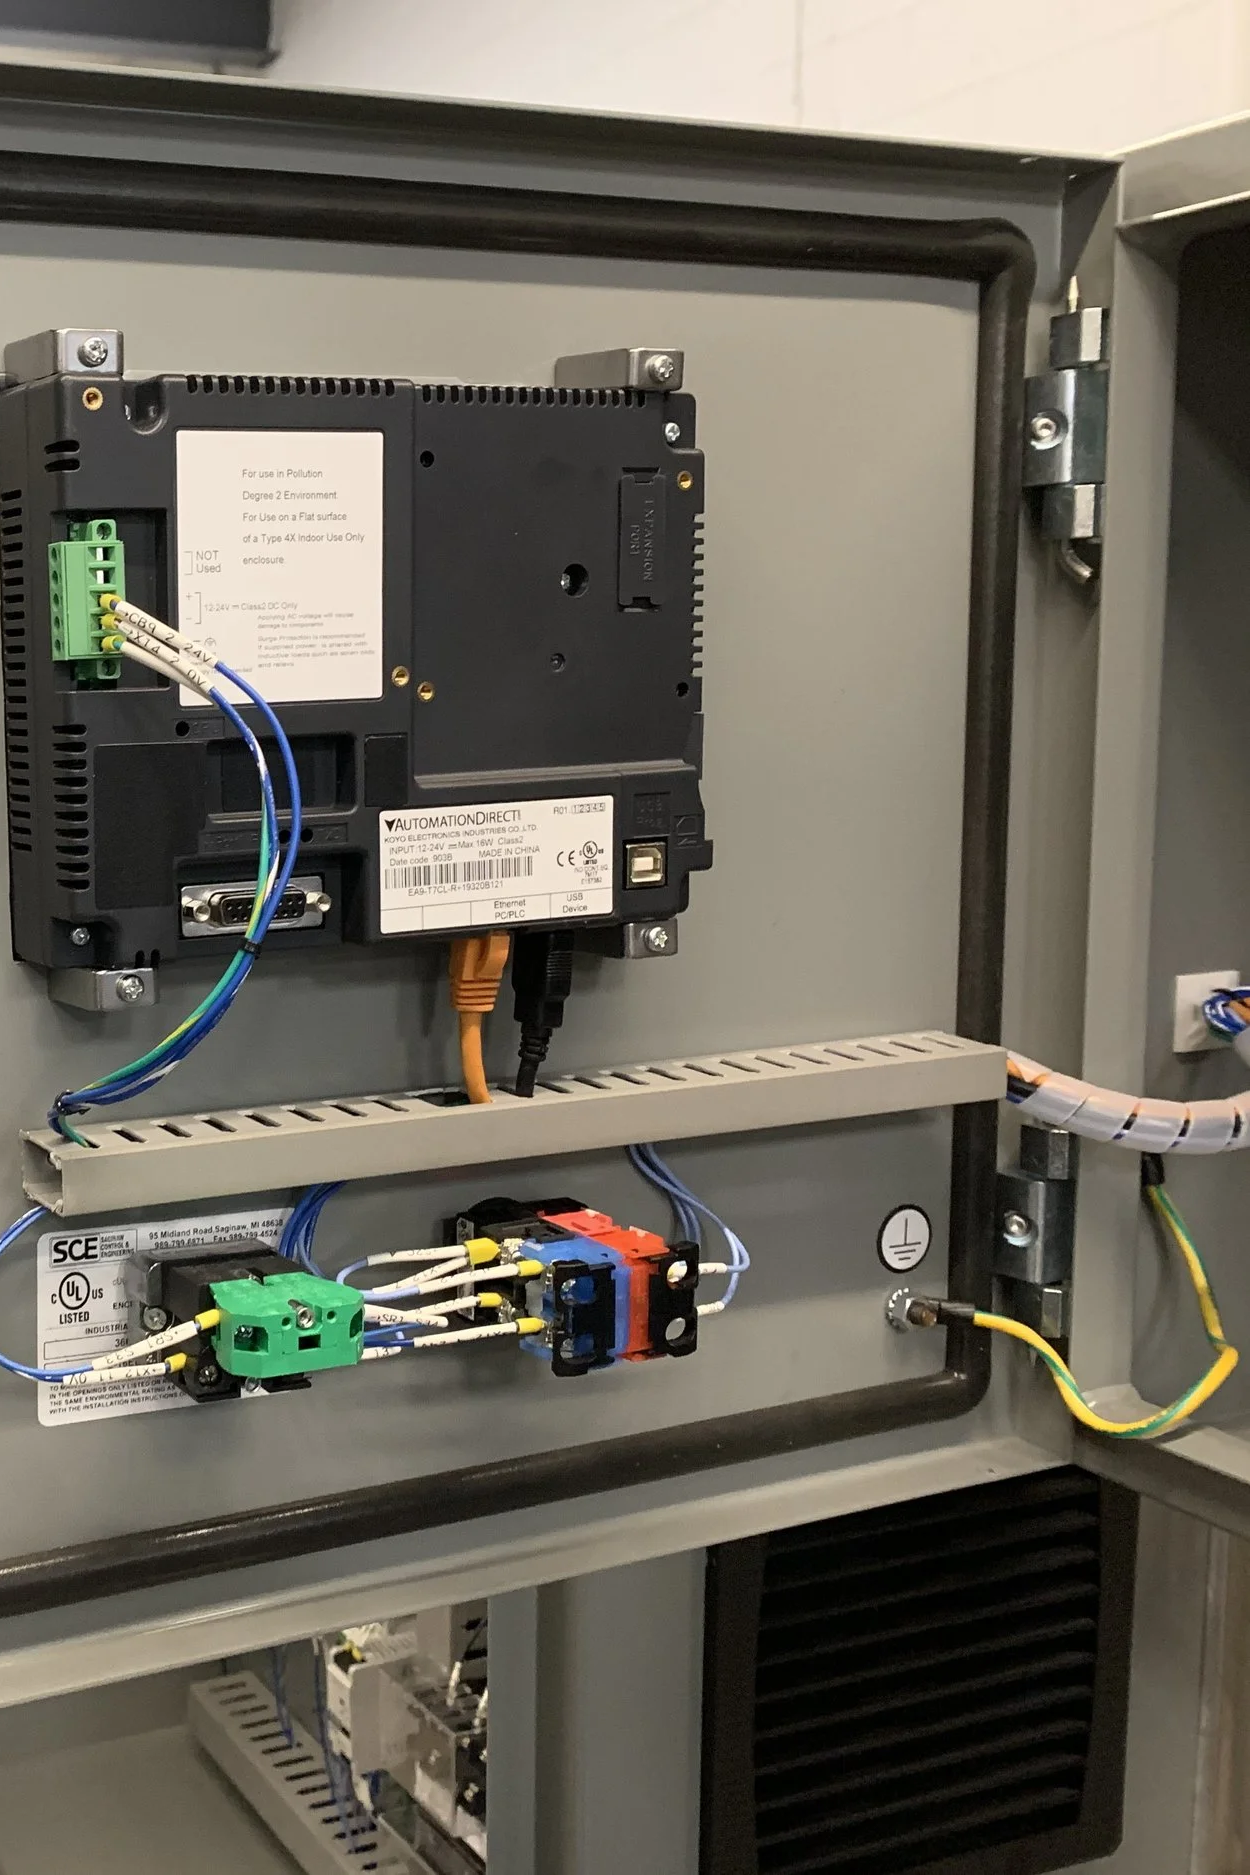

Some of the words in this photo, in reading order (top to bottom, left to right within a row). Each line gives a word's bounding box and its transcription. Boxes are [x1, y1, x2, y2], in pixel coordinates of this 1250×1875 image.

[242, 469, 256, 478] For
[277, 469, 284, 478] in
[286, 469, 323, 478] Pollution
[242, 491, 273, 502] Degree
[276, 491, 281, 500] 2
[243, 513, 257, 521] For
[259, 512, 276, 521] Use
[299, 512, 314, 521] Flat
[317, 512, 347, 520] surface
[243, 534, 251, 543] of
[261, 534, 282, 544] Type
[285, 533, 295, 542] 4X
[298, 533, 324, 542] Indoor
[326, 533, 343, 541] Use
[345, 532, 365, 543] Only
[196, 550, 219, 560] NOT
[196, 564, 221, 573] Used
[281, 602, 298, 611] Only
[129, 612, 156, 634] CB9
[165, 632, 175, 643] 2
[184, 642, 212, 663] 24V
[134, 632, 160, 654] X14
[170, 656, 180, 664] 2
[384, 836, 406, 844] KOYO
[408, 831, 460, 842] ELECTRONICS
[462, 826, 506, 836] INDUSTRIES
[479, 848, 502, 858] MADE
[504, 847, 512, 855] IN
[515, 846, 540, 855] CHINA
[390, 857, 409, 866] Date
[567, 893, 583, 902] USB
[494, 899, 526, 909] Ethernet
[563, 904, 588, 913] Device
[495, 910, 525, 920] PC/PLC
[161, 1229, 190, 1239] Midland
[53, 1237, 98, 1263] SCE
[51, 1293, 57, 1304] C
[92, 1288, 104, 1299] US
[67, 1281, 82, 1301] UL
[59, 1311, 89, 1324] LISTED
[85, 1323, 128, 1335] INDUSTRIA
[73, 1387, 107, 1396] OPENINGS
[127, 1381, 151, 1389] LISTED
[65, 1397, 83, 1405] SAME
[85, 1390, 140, 1402] ENVIRONMENTAL
[142, 1387, 165, 1395] RATING
[83, 1399, 128, 1410] INSTALLATION
[130, 1392, 177, 1404] INSTRUCTIONS
